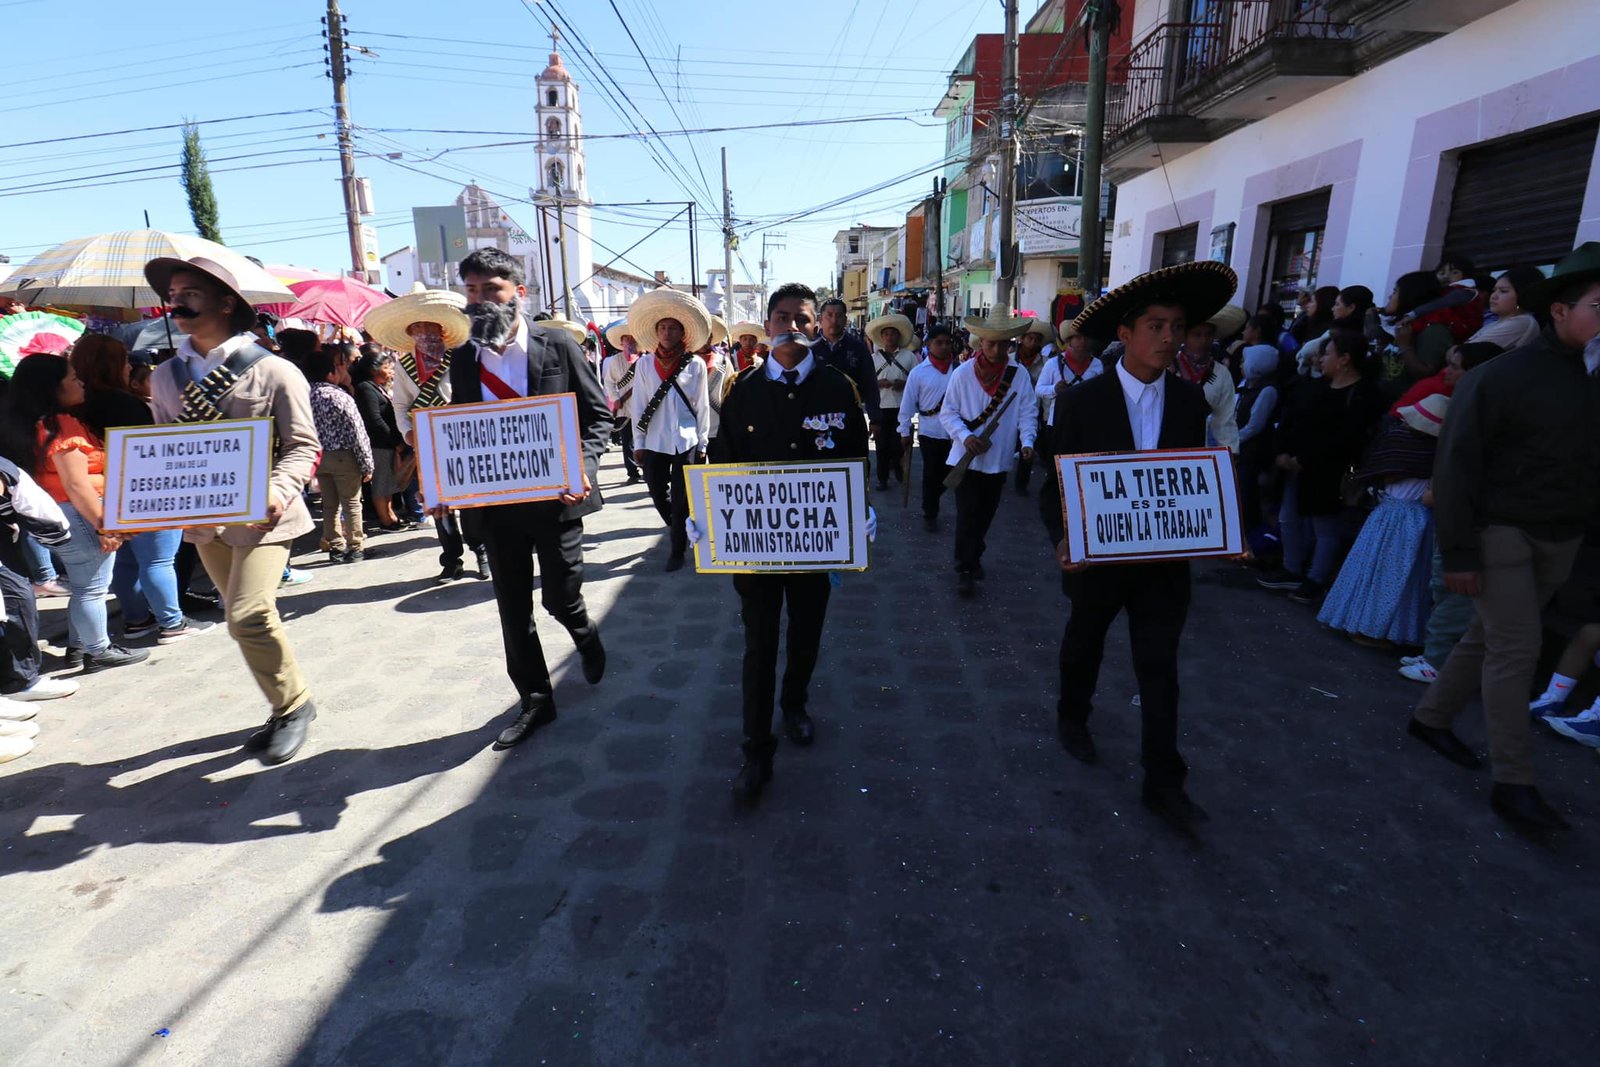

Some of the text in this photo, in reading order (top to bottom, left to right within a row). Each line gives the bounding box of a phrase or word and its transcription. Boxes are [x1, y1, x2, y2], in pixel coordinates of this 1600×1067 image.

[442, 413, 552, 451] "SUFRAGIO EFECTIVO,
[134, 439, 241, 458] "LA INCULTURA
[166, 460, 208, 470] ES UNA DE LAS
[446, 448, 554, 486] NO REELECCION"
[131, 472, 236, 492] DESGRACIAS MAS
[718, 481, 837, 504] "POCA POLITICA
[1090, 467, 1209, 499] "LA TIERRA
[129, 493, 239, 513] GRANDES DE MI RAZA"
[1131, 499, 1176, 509] ES DE
[720, 507, 838, 529] Y MUCHA
[1096, 508, 1212, 545] QUIEN LA TRABAJA"
[725, 531, 839, 552] ADMINISTRACION"
